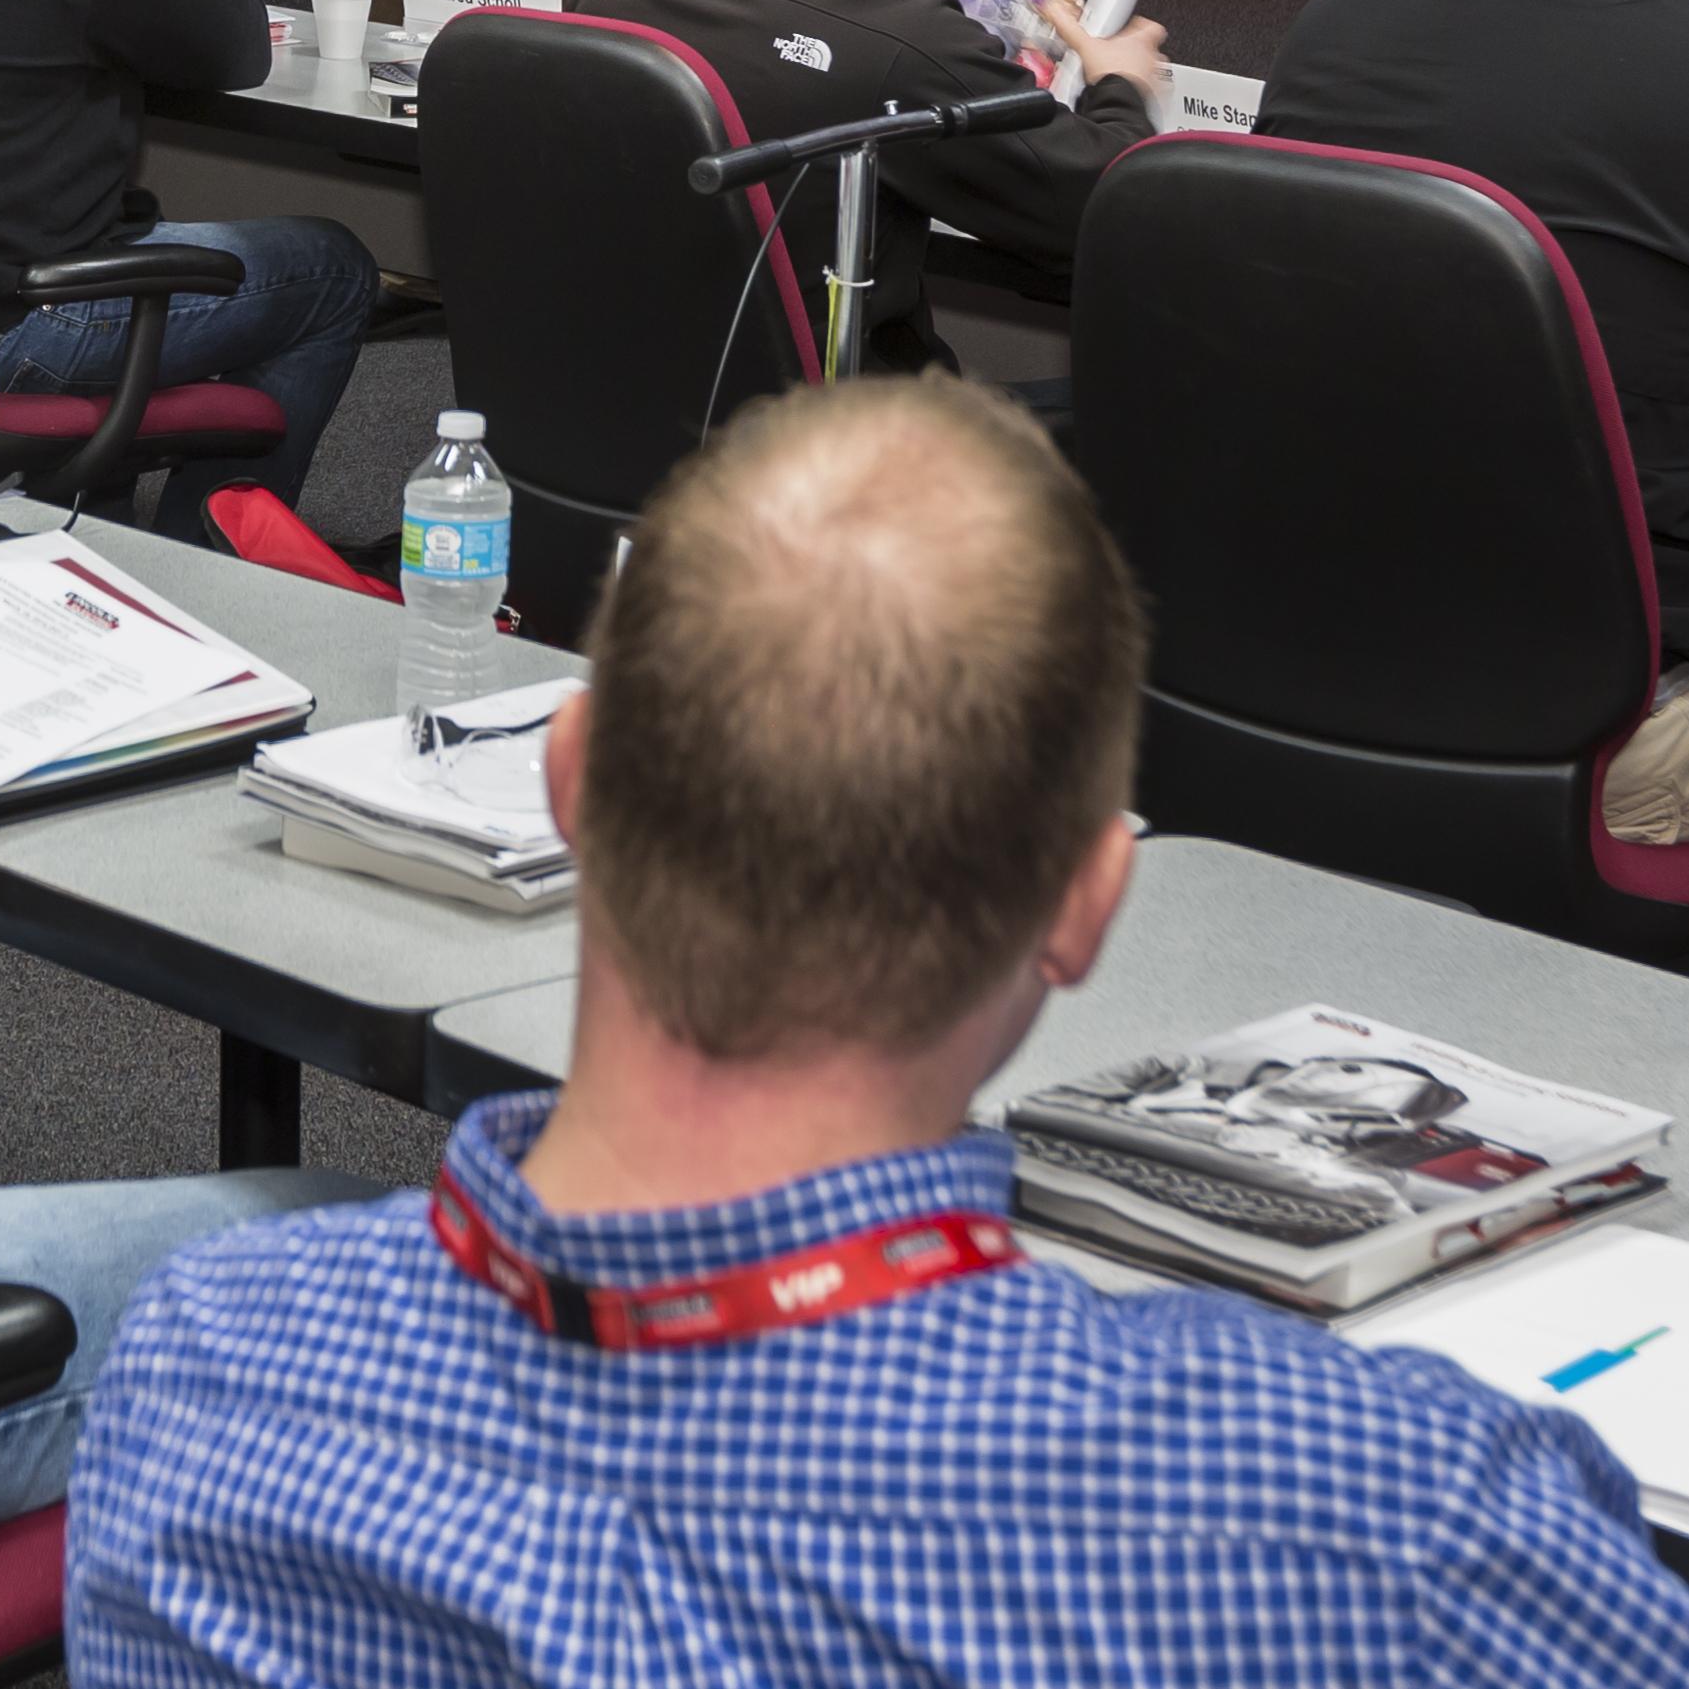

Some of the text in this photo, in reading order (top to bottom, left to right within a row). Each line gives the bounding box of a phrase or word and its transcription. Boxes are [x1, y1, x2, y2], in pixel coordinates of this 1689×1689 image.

[773, 37, 812, 57] NORTH
[792, 32, 815, 48] THE
[780, 49, 810, 65] FACE
[1183, 96, 1218, 120] Mike
[768, 1261, 844, 1312] VIP
